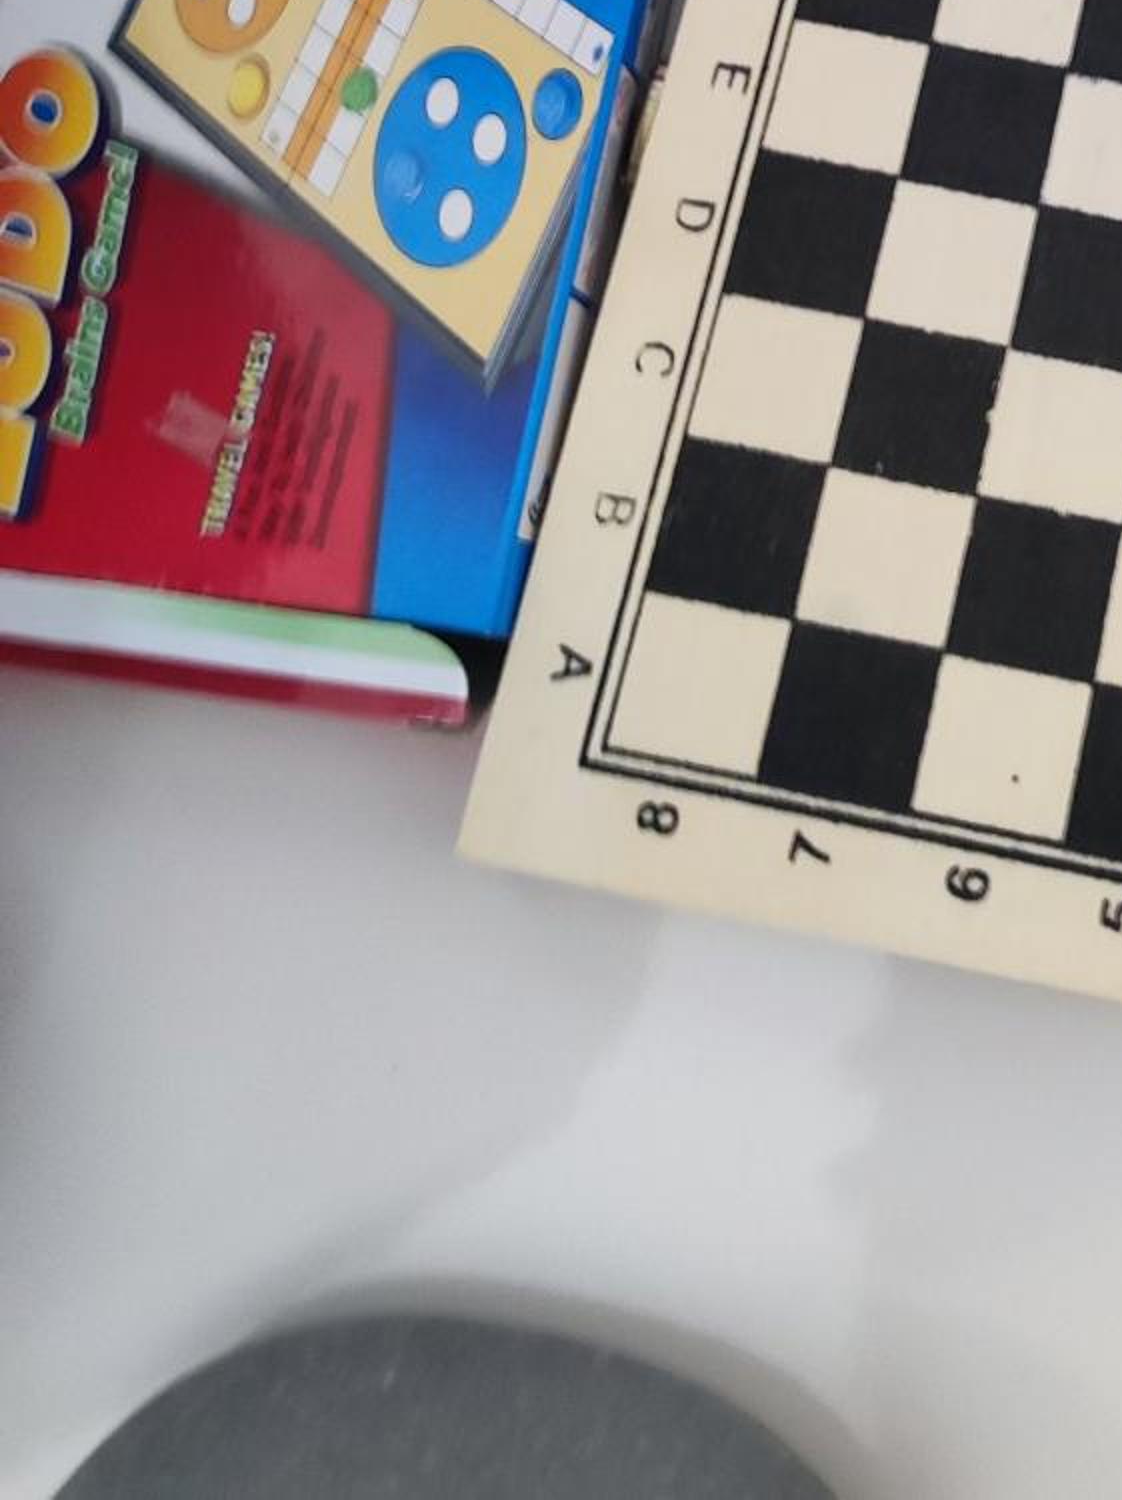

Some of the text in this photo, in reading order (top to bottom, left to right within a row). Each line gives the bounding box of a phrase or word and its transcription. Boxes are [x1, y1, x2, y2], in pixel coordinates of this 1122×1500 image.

[712, 61, 753, 95] E
[675, 198, 716, 232] D
[50, 139, 139, 447] Brains Game!
[635, 341, 675, 379] C
[200, 438, 249, 536] TRAVEL
[595, 492, 636, 528] B
[550, 644, 594, 683] A
[637, 801, 680, 835] 8
[789, 831, 833, 866] 7
[946, 865, 990, 902] 6
